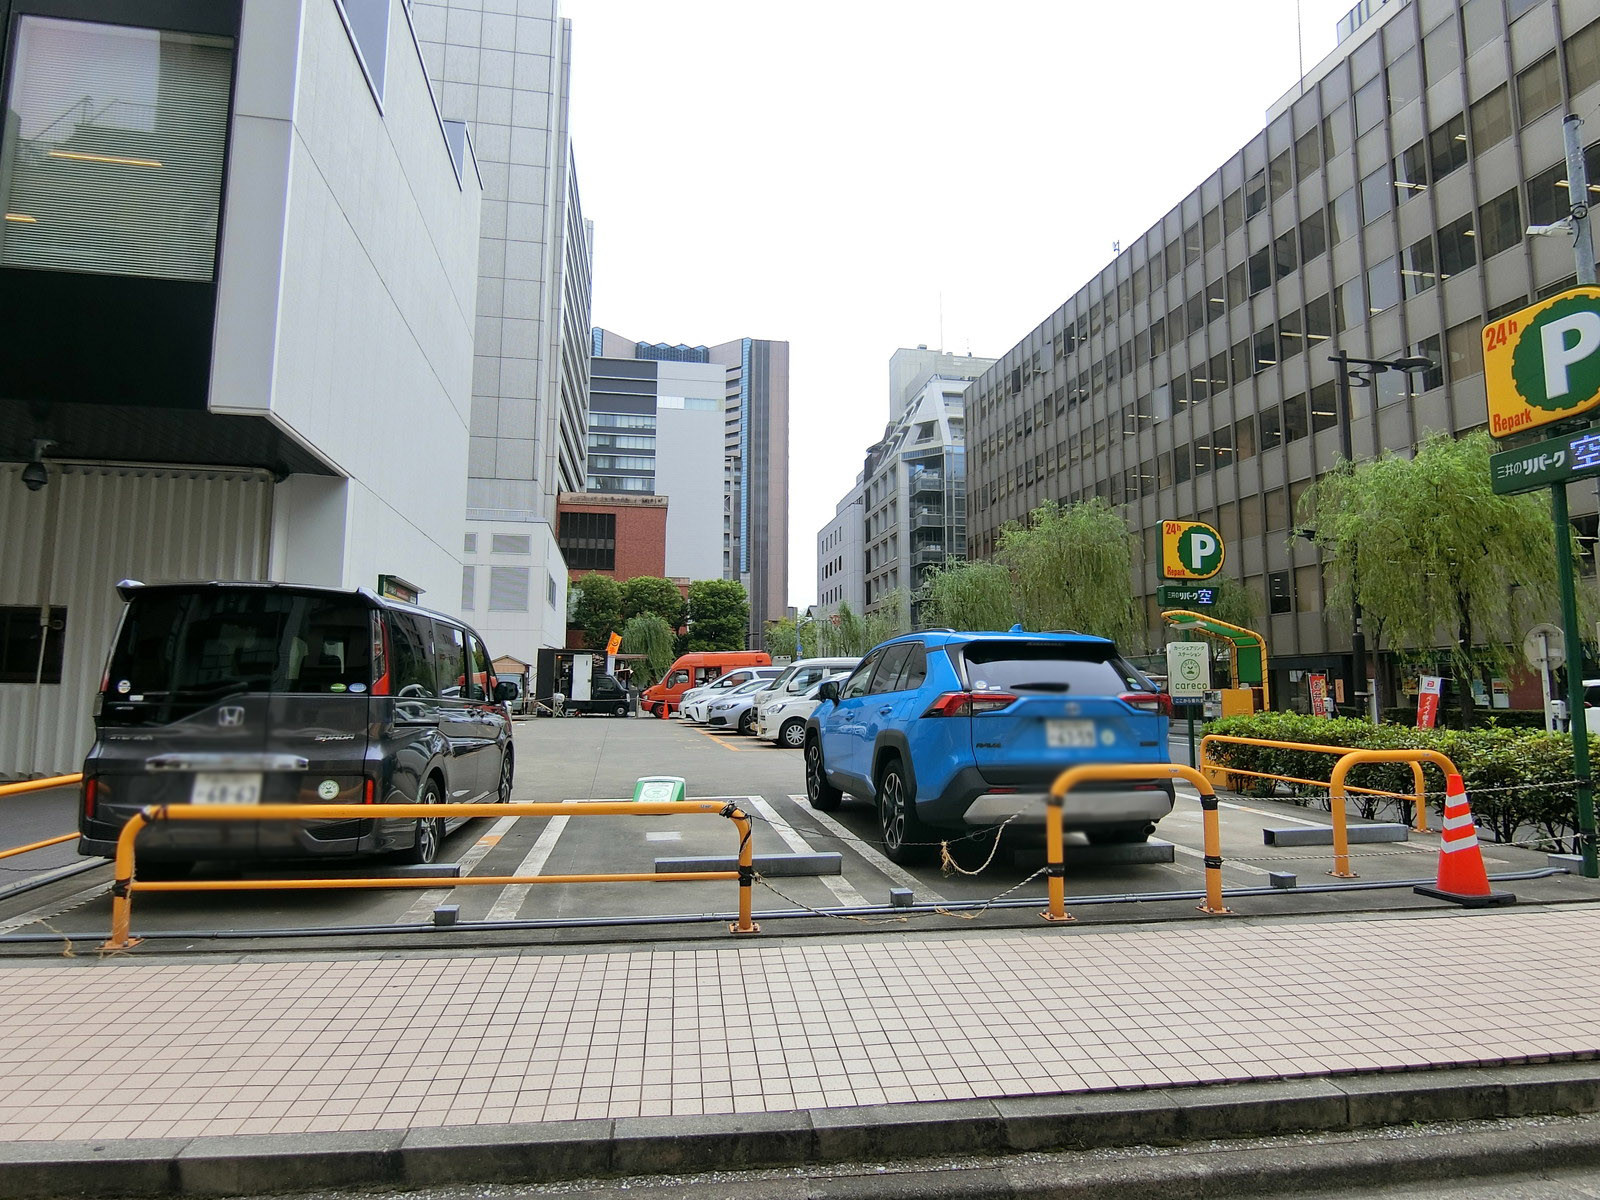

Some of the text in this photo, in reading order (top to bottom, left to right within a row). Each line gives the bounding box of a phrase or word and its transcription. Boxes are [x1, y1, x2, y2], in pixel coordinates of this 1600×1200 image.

[1485, 319, 1518, 352] 24h
[1540, 311, 1600, 399] P
[1493, 408, 1533, 433] Repark
[1497, 450, 1565, 479] 三井のリパーク
[1570, 435, 1600, 470] 空
[1166, 523, 1182, 535] 24h
[1191, 533, 1215, 569] P
[1167, 566, 1186, 577] Repark
[1197, 588, 1213, 604] 空
